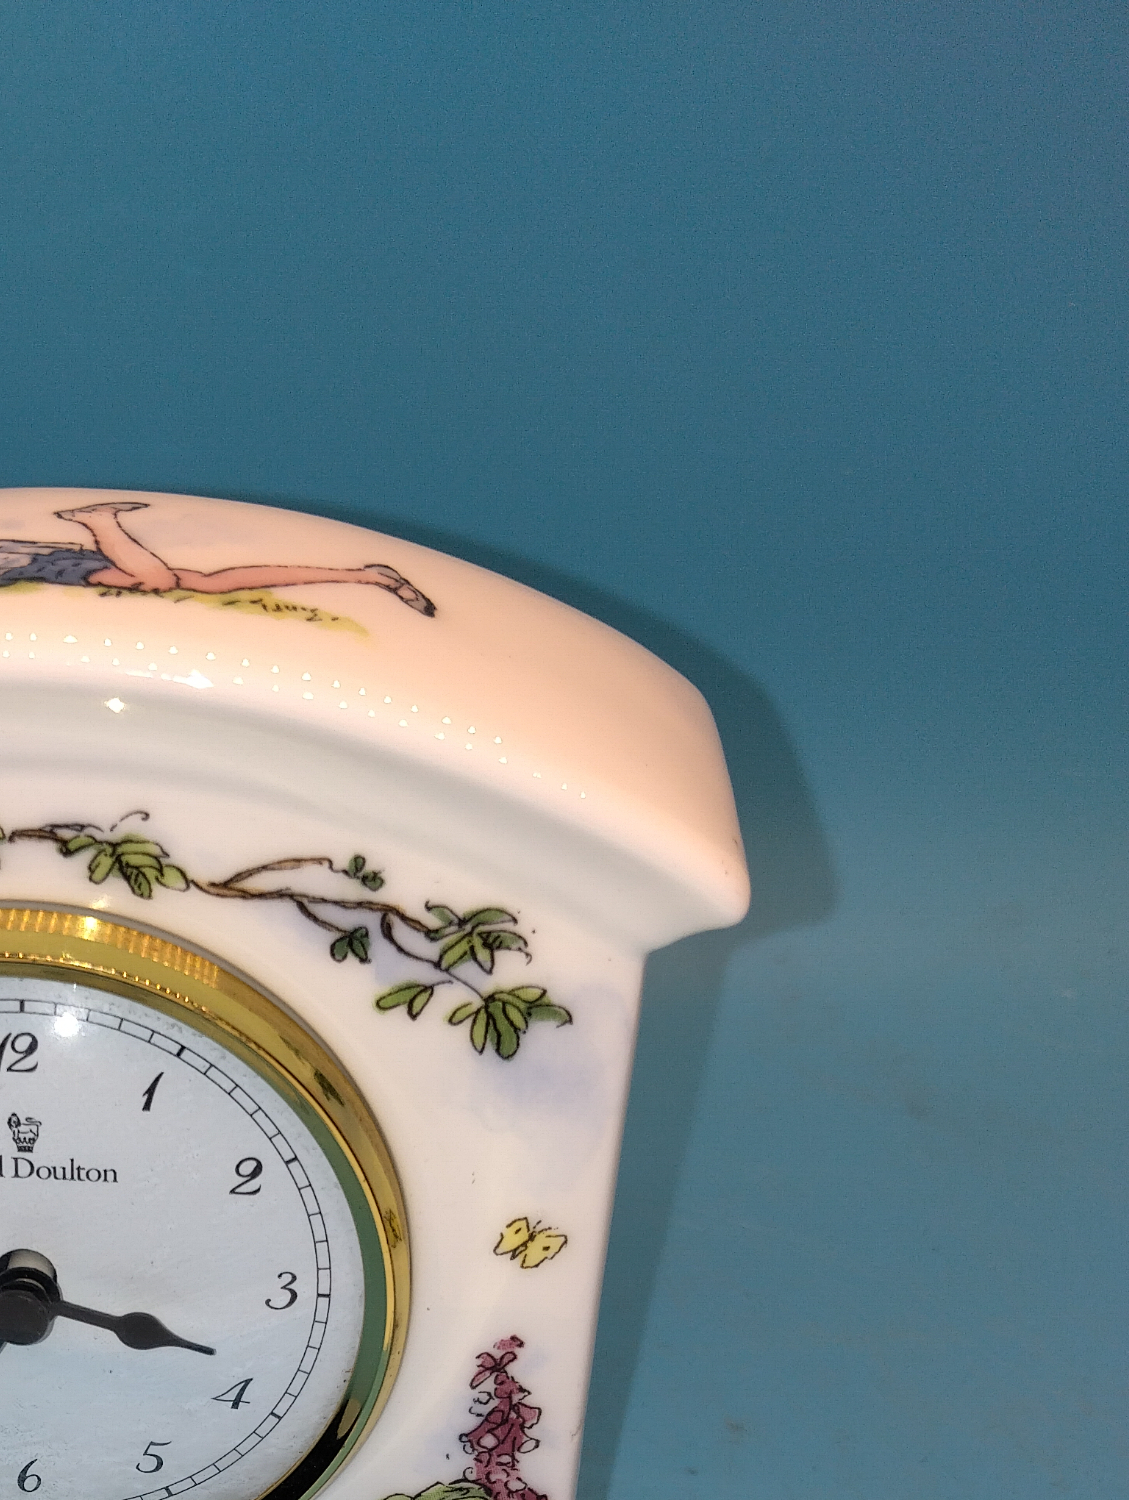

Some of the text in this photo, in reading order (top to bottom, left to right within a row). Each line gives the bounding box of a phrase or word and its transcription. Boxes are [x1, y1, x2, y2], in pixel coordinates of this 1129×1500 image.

[141, 1071, 164, 1112] 1
[11, 1157, 118, 1185] Doulton
[229, 1157, 264, 1196] 2
[265, 1271, 298, 1311] 3
[212, 1377, 254, 1411] 4
[135, 1441, 172, 1474] 5
[16, 1459, 43, 1494] 6
